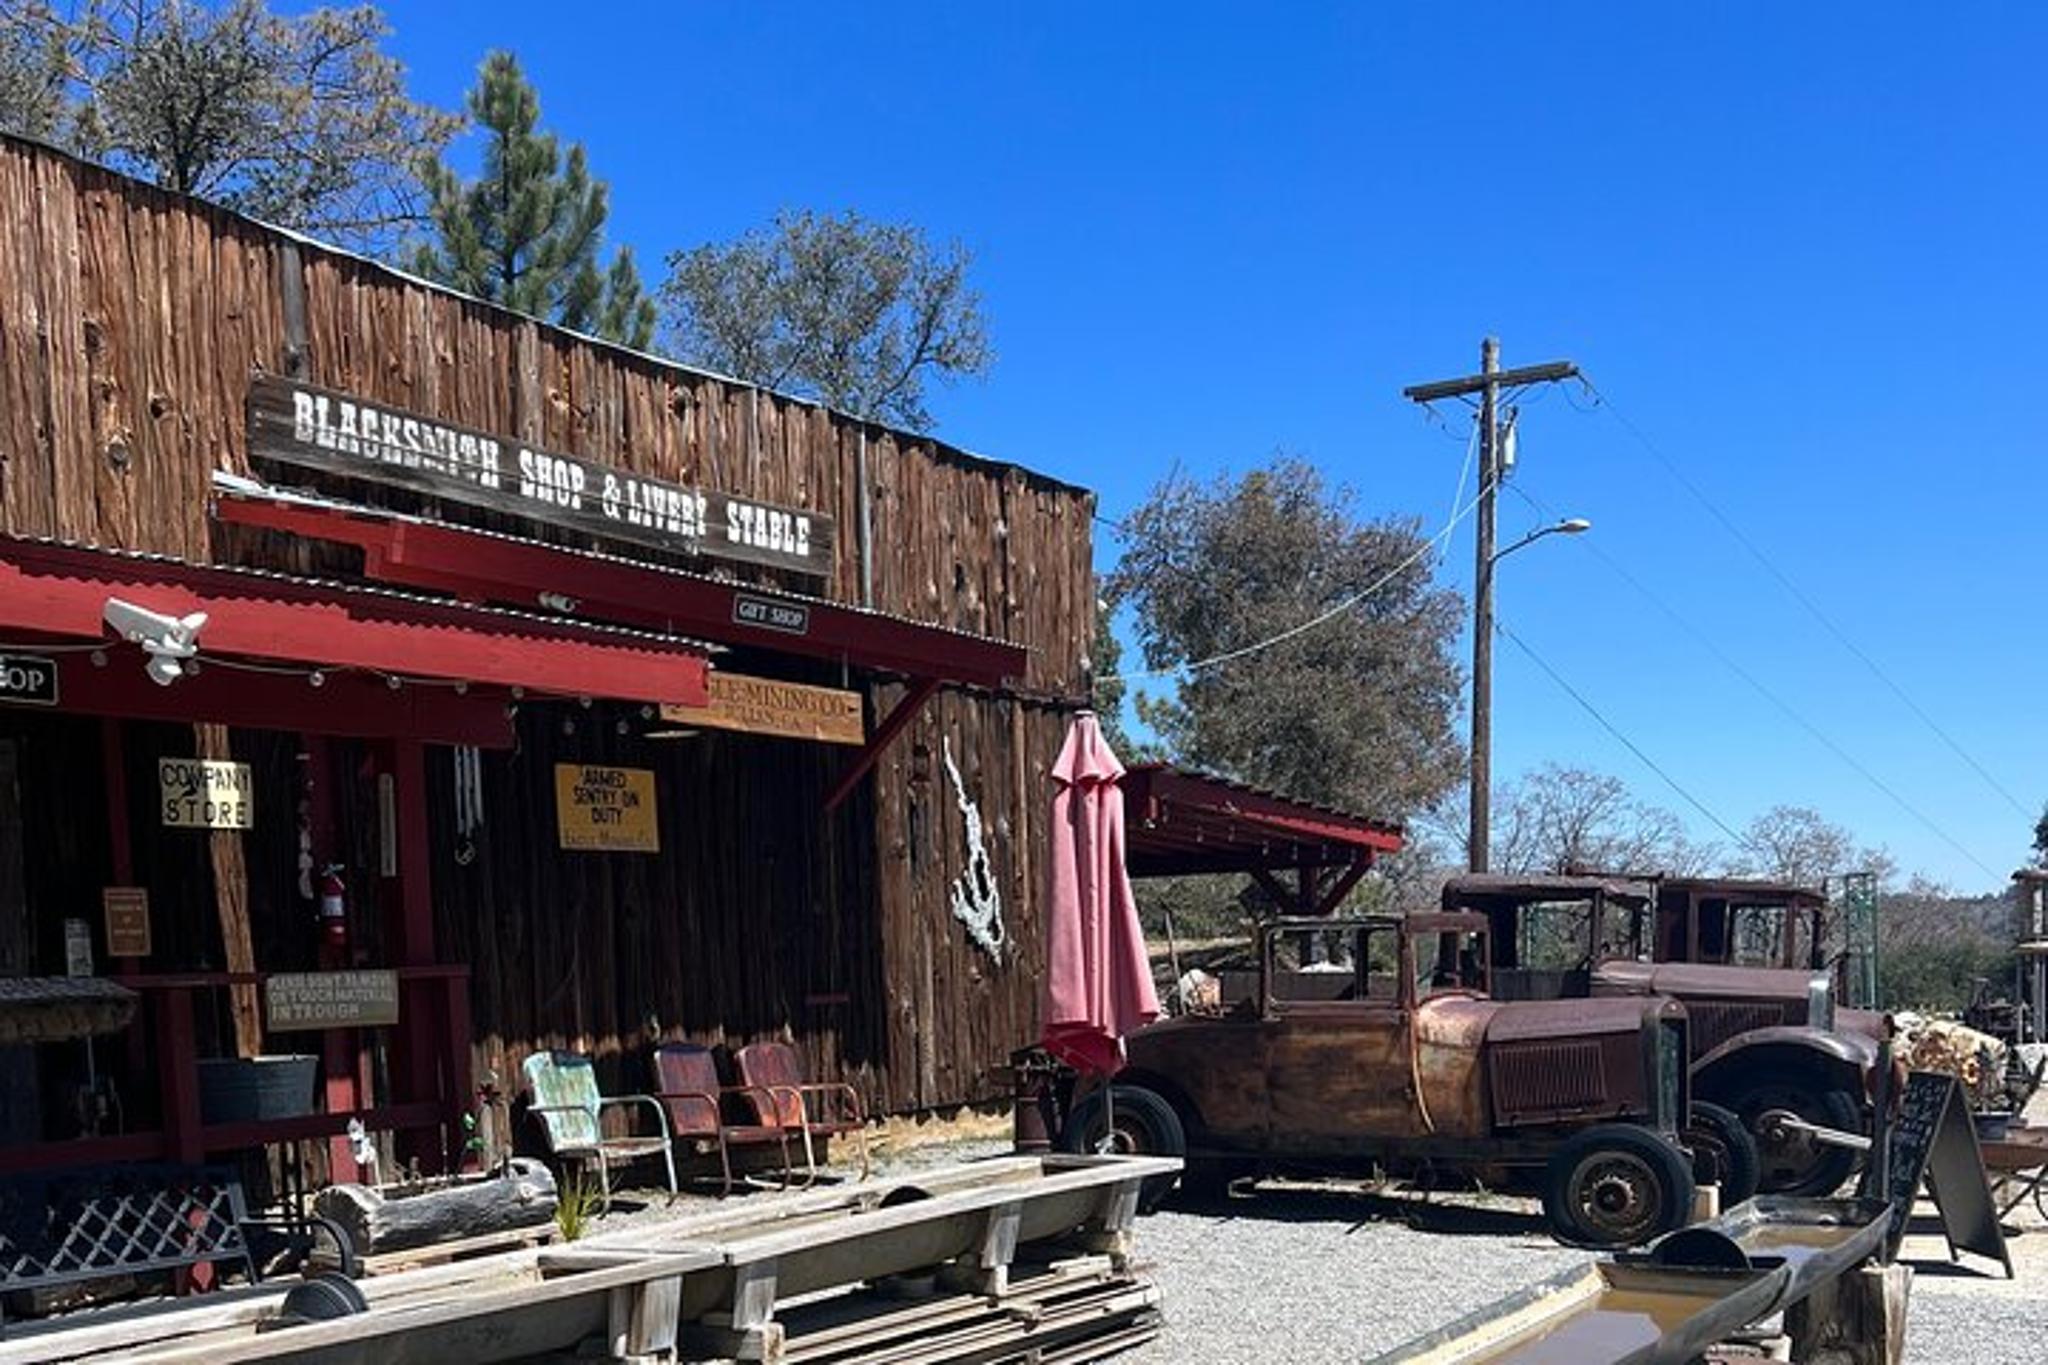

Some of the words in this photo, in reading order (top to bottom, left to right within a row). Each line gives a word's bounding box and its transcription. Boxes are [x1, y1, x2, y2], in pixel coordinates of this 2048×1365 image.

[293, 391, 499, 489] BLACKSMITH
[518, 448, 585, 511] SHOP
[602, 474, 621, 521] &
[627, 479, 708, 537] LIVERY
[726, 501, 812, 557] STABLE
[739, 601, 767, 621] GIFT
[770, 607, 803, 627] SHOP
[162, 763, 249, 792] COMPANY
[573, 784, 618, 806] SENTRY
[622, 789, 640, 809] ON
[167, 798, 247, 826] STORE
[591, 806, 623, 825] DUTY
[293, 1002, 360, 1019] TROUGH
